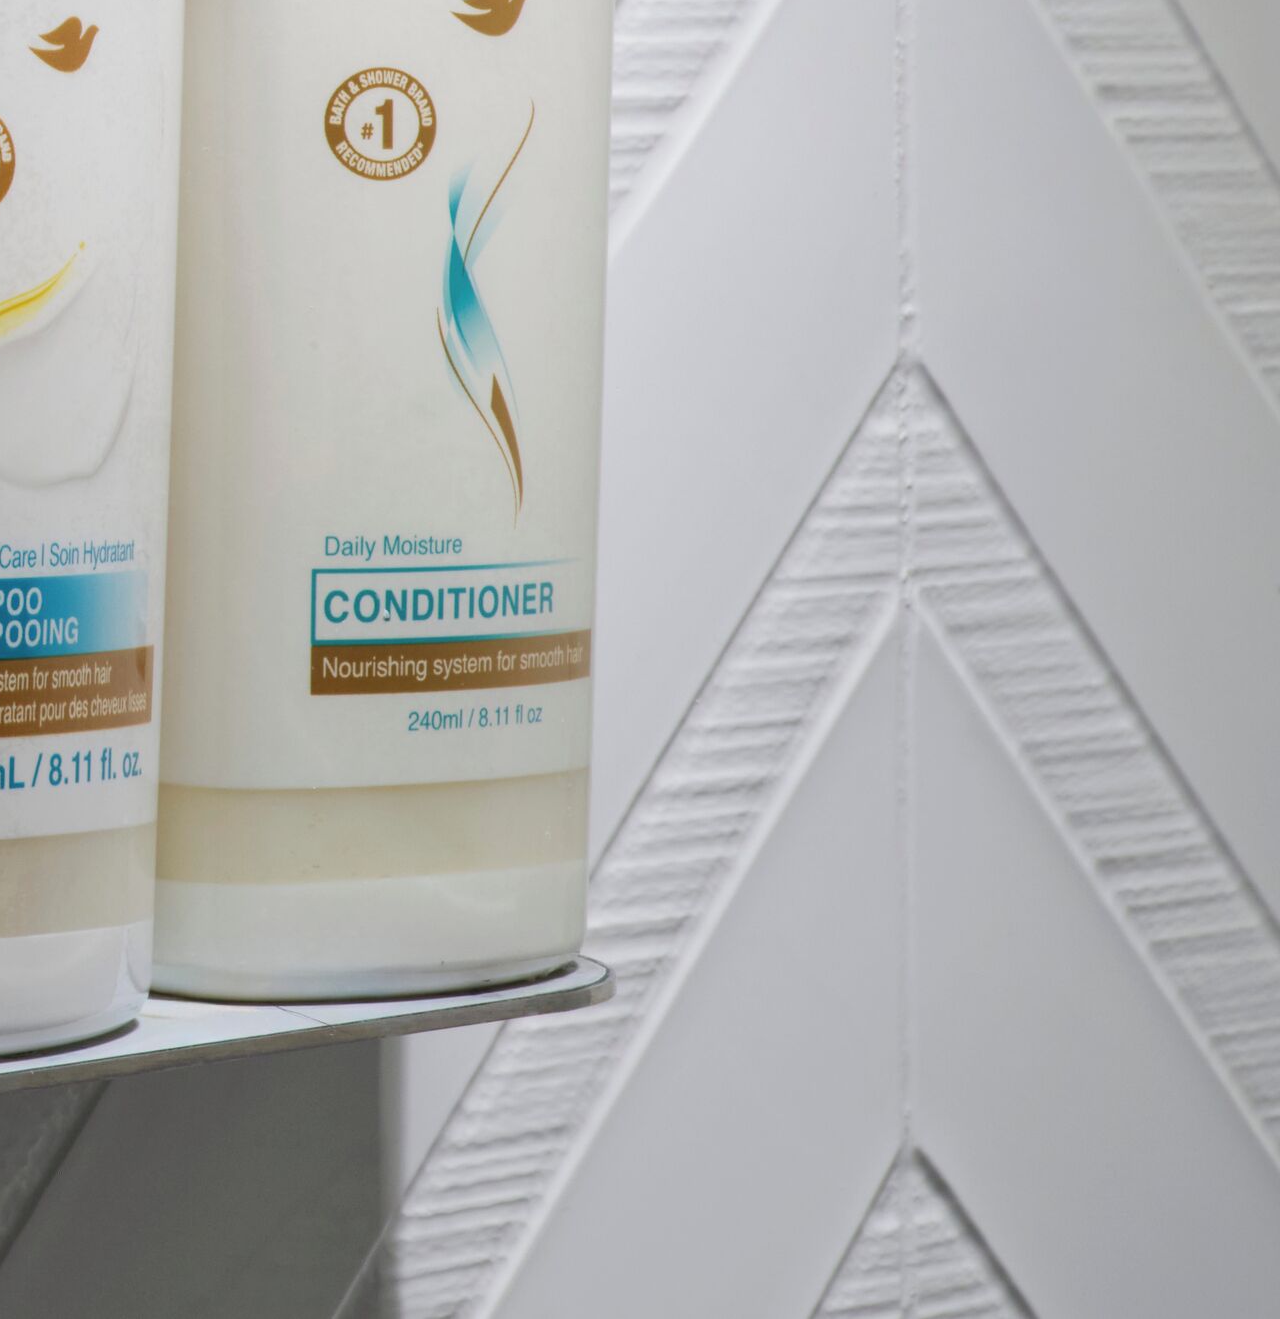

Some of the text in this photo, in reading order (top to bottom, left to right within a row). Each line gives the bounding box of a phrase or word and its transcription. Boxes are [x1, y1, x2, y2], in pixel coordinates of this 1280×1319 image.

[329, 70, 432, 126] BATH & SHOWER BRAND
[50, 542, 79, 565] Soin
[83, 540, 134, 570] Hydratant
[325, 535, 462, 560] Daily Moisture
[324, 582, 553, 623] CONDITIONER
[33, 667, 48, 689] for
[52, 663, 92, 688] smooth
[94, 662, 112, 683] hair
[323, 644, 583, 681] Nourishing system for smooth hair
[40, 701, 65, 726] pour
[69, 696, 88, 718] des
[91, 694, 127, 716] cheveux
[128, 692, 147, 711] lisses
[408, 705, 542, 731] 240ml / 8.11 fl oz
[32, 753, 42, 787] /
[49, 751, 91, 786] 8.11
[101, 748, 116, 781] fl.
[123, 752, 141, 777] oz.
